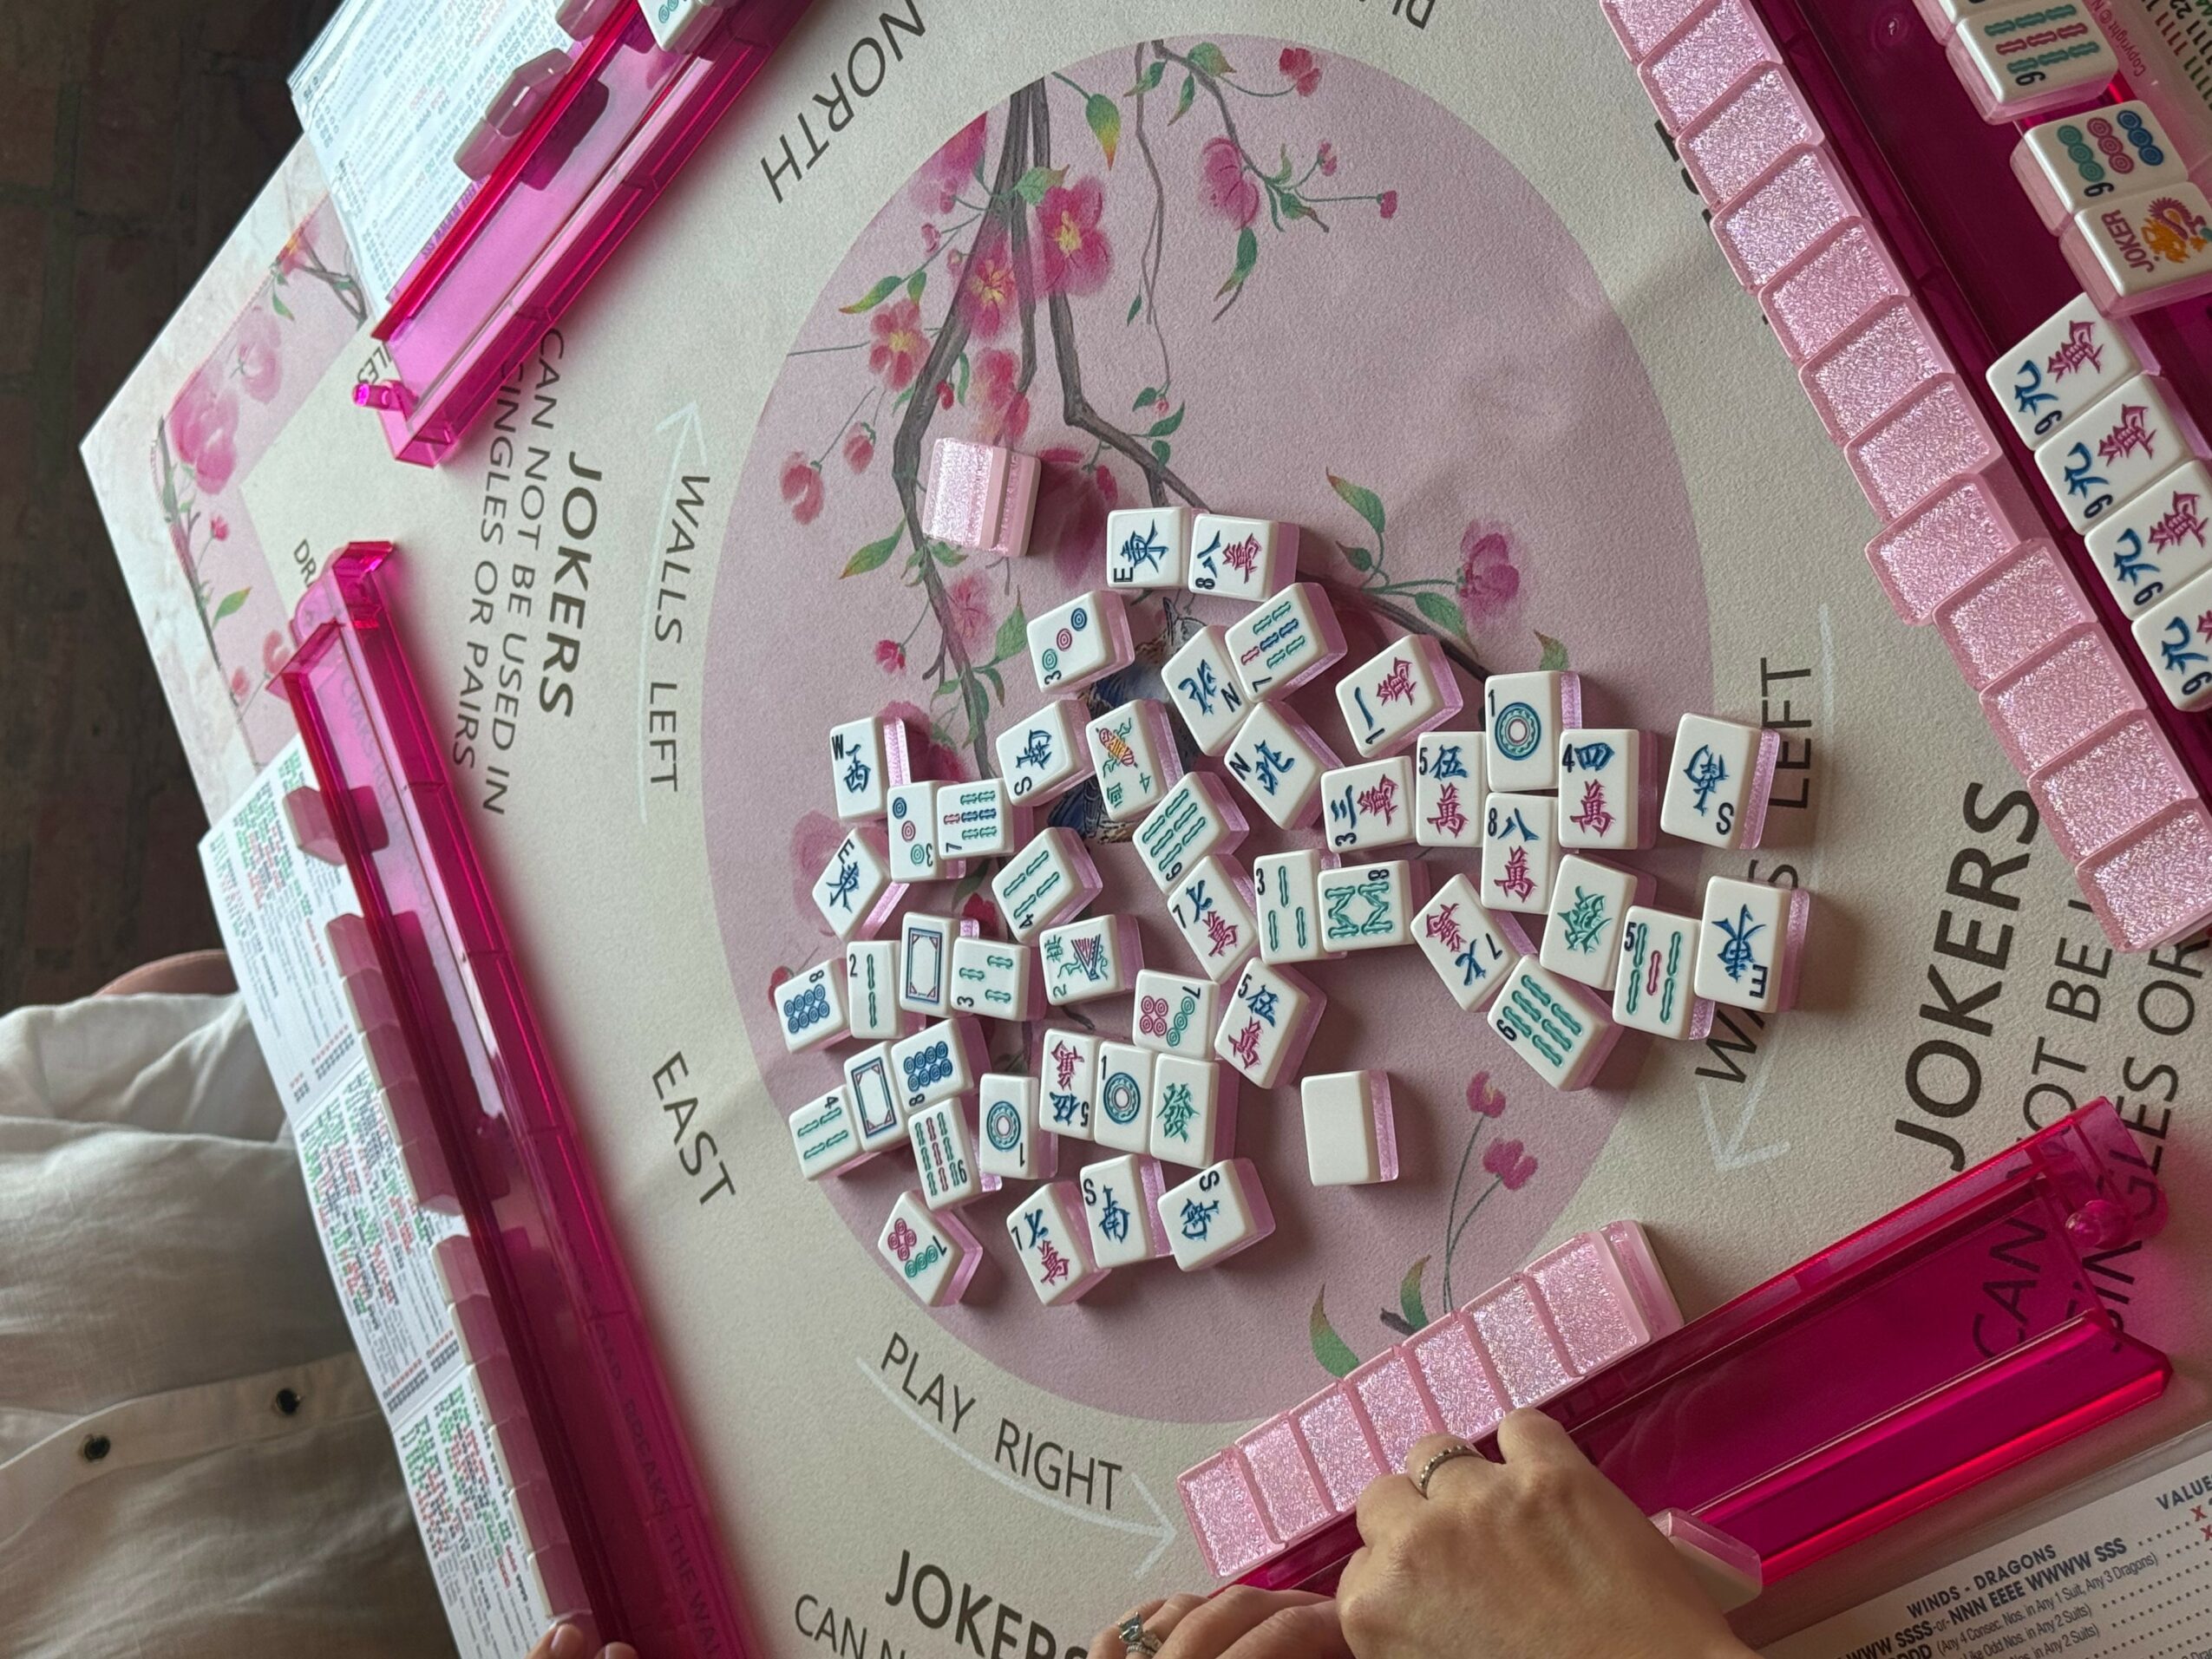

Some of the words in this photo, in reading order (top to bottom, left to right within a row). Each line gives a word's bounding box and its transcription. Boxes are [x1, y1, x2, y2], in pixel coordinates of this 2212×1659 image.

[2108, 21, 2146, 77] Copyright
[2015, 71, 2046, 87] 9
[761, 0, 926, 204] NORTH
[2083, 182, 2115, 198] 9
[2101, 209, 2156, 273] JOKER
[531, 328, 564, 430] CAN
[2034, 410, 2063, 435] 9
[518, 447, 550, 551] NOT
[2084, 493, 2113, 519] 9
[654, 474, 710, 644] WALLS
[540, 451, 603, 717] JOKERS
[1114, 566, 1134, 583] E
[1196, 578, 1214, 590] 8
[469, 560, 497, 625] OR
[507, 564, 535, 617] BE
[2133, 582, 2164, 607] 9
[1044, 669, 1062, 685] 3
[1253, 676, 1273, 692] 7
[2182, 671, 2212, 696] 9
[492, 632, 527, 751] USED
[1221, 682, 1242, 712] N
[1488, 689, 1495, 717] 1
[452, 642, 489, 769] PAIRS
[649, 682, 678, 793] LEFT
[1365, 728, 1385, 745] 1
[1761, 656, 1812, 809] LEFT
[832, 734, 844, 761] W
[1562, 744, 1574, 773] 4
[1229, 752, 1252, 781] N
[1418, 748, 1428, 775] 5
[482, 766, 510, 815] IN
[1014, 777, 1032, 795] S
[1488, 807, 1497, 836] 8
[1716, 802, 1734, 835] S
[838, 839, 855, 865] E
[946, 842, 963, 852] 7
[1335, 833, 1358, 846] 3
[926, 843, 934, 867] 3
[1257, 868, 1266, 895] 3
[1368, 868, 1391, 881] 8
[1019, 913, 1036, 929] 4
[1173, 905, 1188, 929] 7
[1484, 932, 1503, 961] 7
[1624, 922, 1637, 952] 5
[808, 970, 825, 983] 8
[849, 954, 859, 977] 2
[1894, 781, 2040, 1172] JOKERS
[1182, 986, 1201, 999] 7
[1238, 974, 1252, 997] 5
[1749, 963, 1769, 999] E
[2045, 937, 2112, 1023] BE
[957, 996, 974, 1008] 3
[1101, 1055, 1107, 1081] 1
[824, 1096, 839, 1109] 4
[908, 1094, 926, 1107] 8
[1080, 1101, 1089, 1127] 5
[652, 1051, 736, 1205] EAST
[1018, 1142, 1025, 1168] 1
[1083, 1178, 1097, 1206] S
[1199, 1170, 1221, 1192] S
[1011, 1225, 1024, 1251] 7
[880, 1331, 977, 1434] PLAY
[994, 1417, 1122, 1511] RIGHT
[1907, 1585, 1960, 1618] WINDS
[1973, 1545, 2056, 1590] DRAGONS
[1988, 1580, 2025, 1608] EEEE
[2025, 1551, 2091, 1590] WWWW
[2094, 1538, 2127, 1563] SSS
[1936, 1636, 1959, 1656] (Any
[1967, 1619, 2004, 1642] Consec.
[2002, 1610, 2025, 1626] Nos.
[2027, 1603, 2036, 1617] in
[2036, 1597, 2054, 1612] Any
[2085, 1575, 2104, 1593] Any
[2104, 1571, 2113, 1584] 3
[2113, 1551, 2158, 1580] Dragons)
[795, 1594, 867, 1659] CAN
[1983, 1640, 2002, 1657] Odd
[2002, 1630, 2025, 1648] Nos.
[2026, 1624, 2036, 1639] in
[2035, 1618, 2054, 1634] Any
[2054, 1614, 2065, 1628] 2
[2063, 1603, 2092, 1624] Suits)
[2032, 1644, 2043, 1658] in
[2043, 1638, 2063, 1654] Any
[2061, 1634, 2071, 1648] 2
[2070, 1623, 2100, 1643] Suits)
